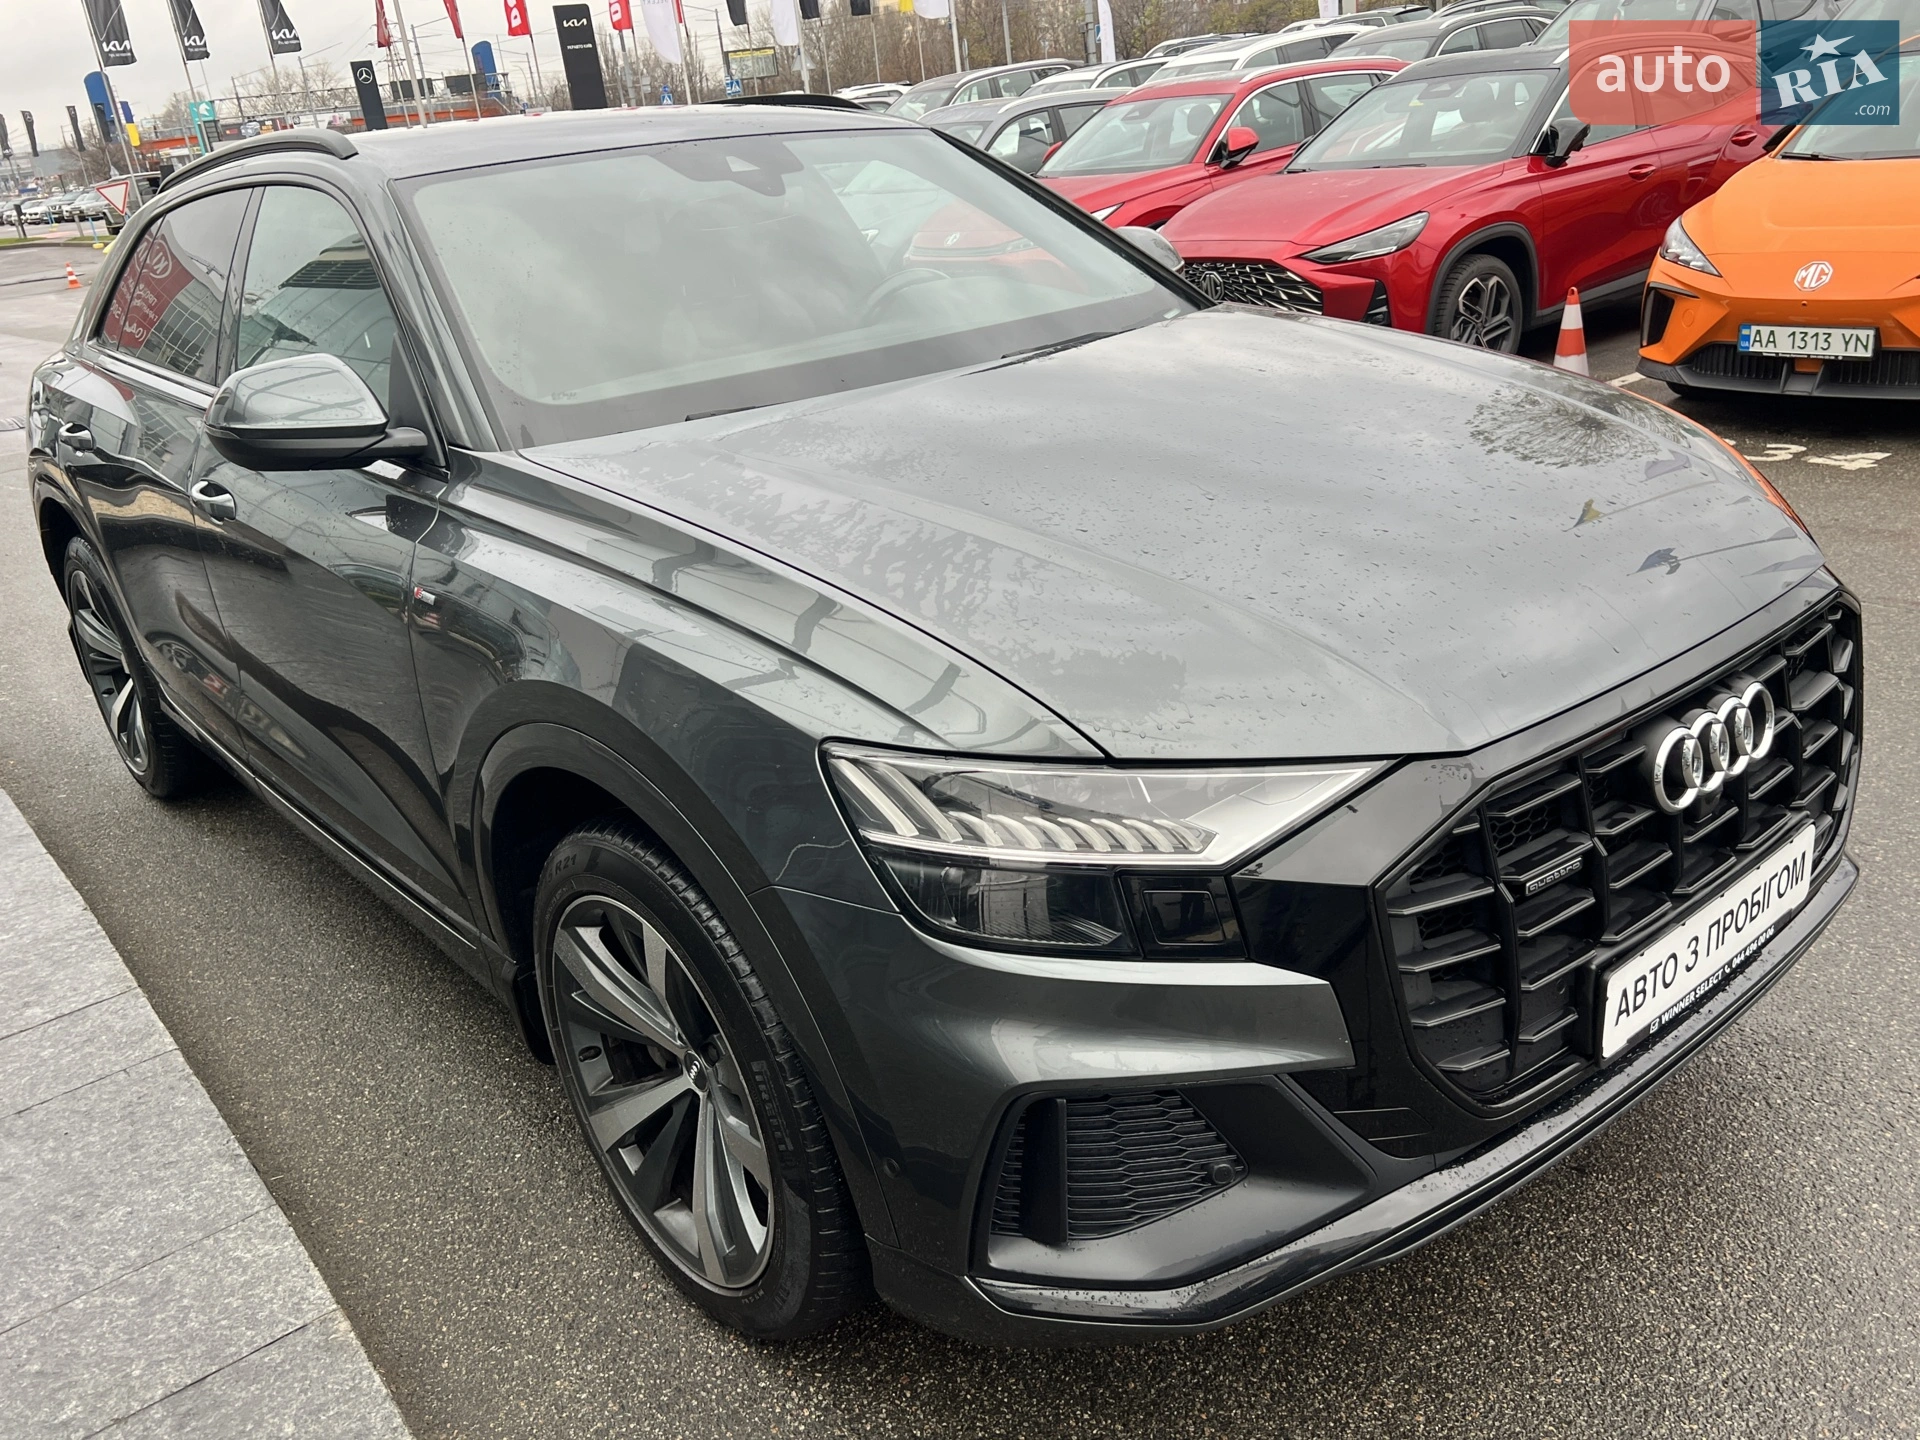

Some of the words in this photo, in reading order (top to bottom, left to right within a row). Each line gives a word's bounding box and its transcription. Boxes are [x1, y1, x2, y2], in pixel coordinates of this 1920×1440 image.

[563, 18, 587, 28] KIA
[102, 40, 132, 52] KIA
[1796, 262, 1831, 289] MG
[1751, 329, 1777, 349] AA
[1787, 330, 1833, 352] 1313
[1841, 332, 1871, 353] YN
[1529, 861, 1581, 891] quattro
[1614, 951, 1678, 1027] АВТО
[1684, 935, 1699, 973] З
[1706, 850, 1807, 958] ПРОБІГОМ
[1660, 992, 1696, 1025] WINNER
[1695, 968, 1724, 998] SELECT
